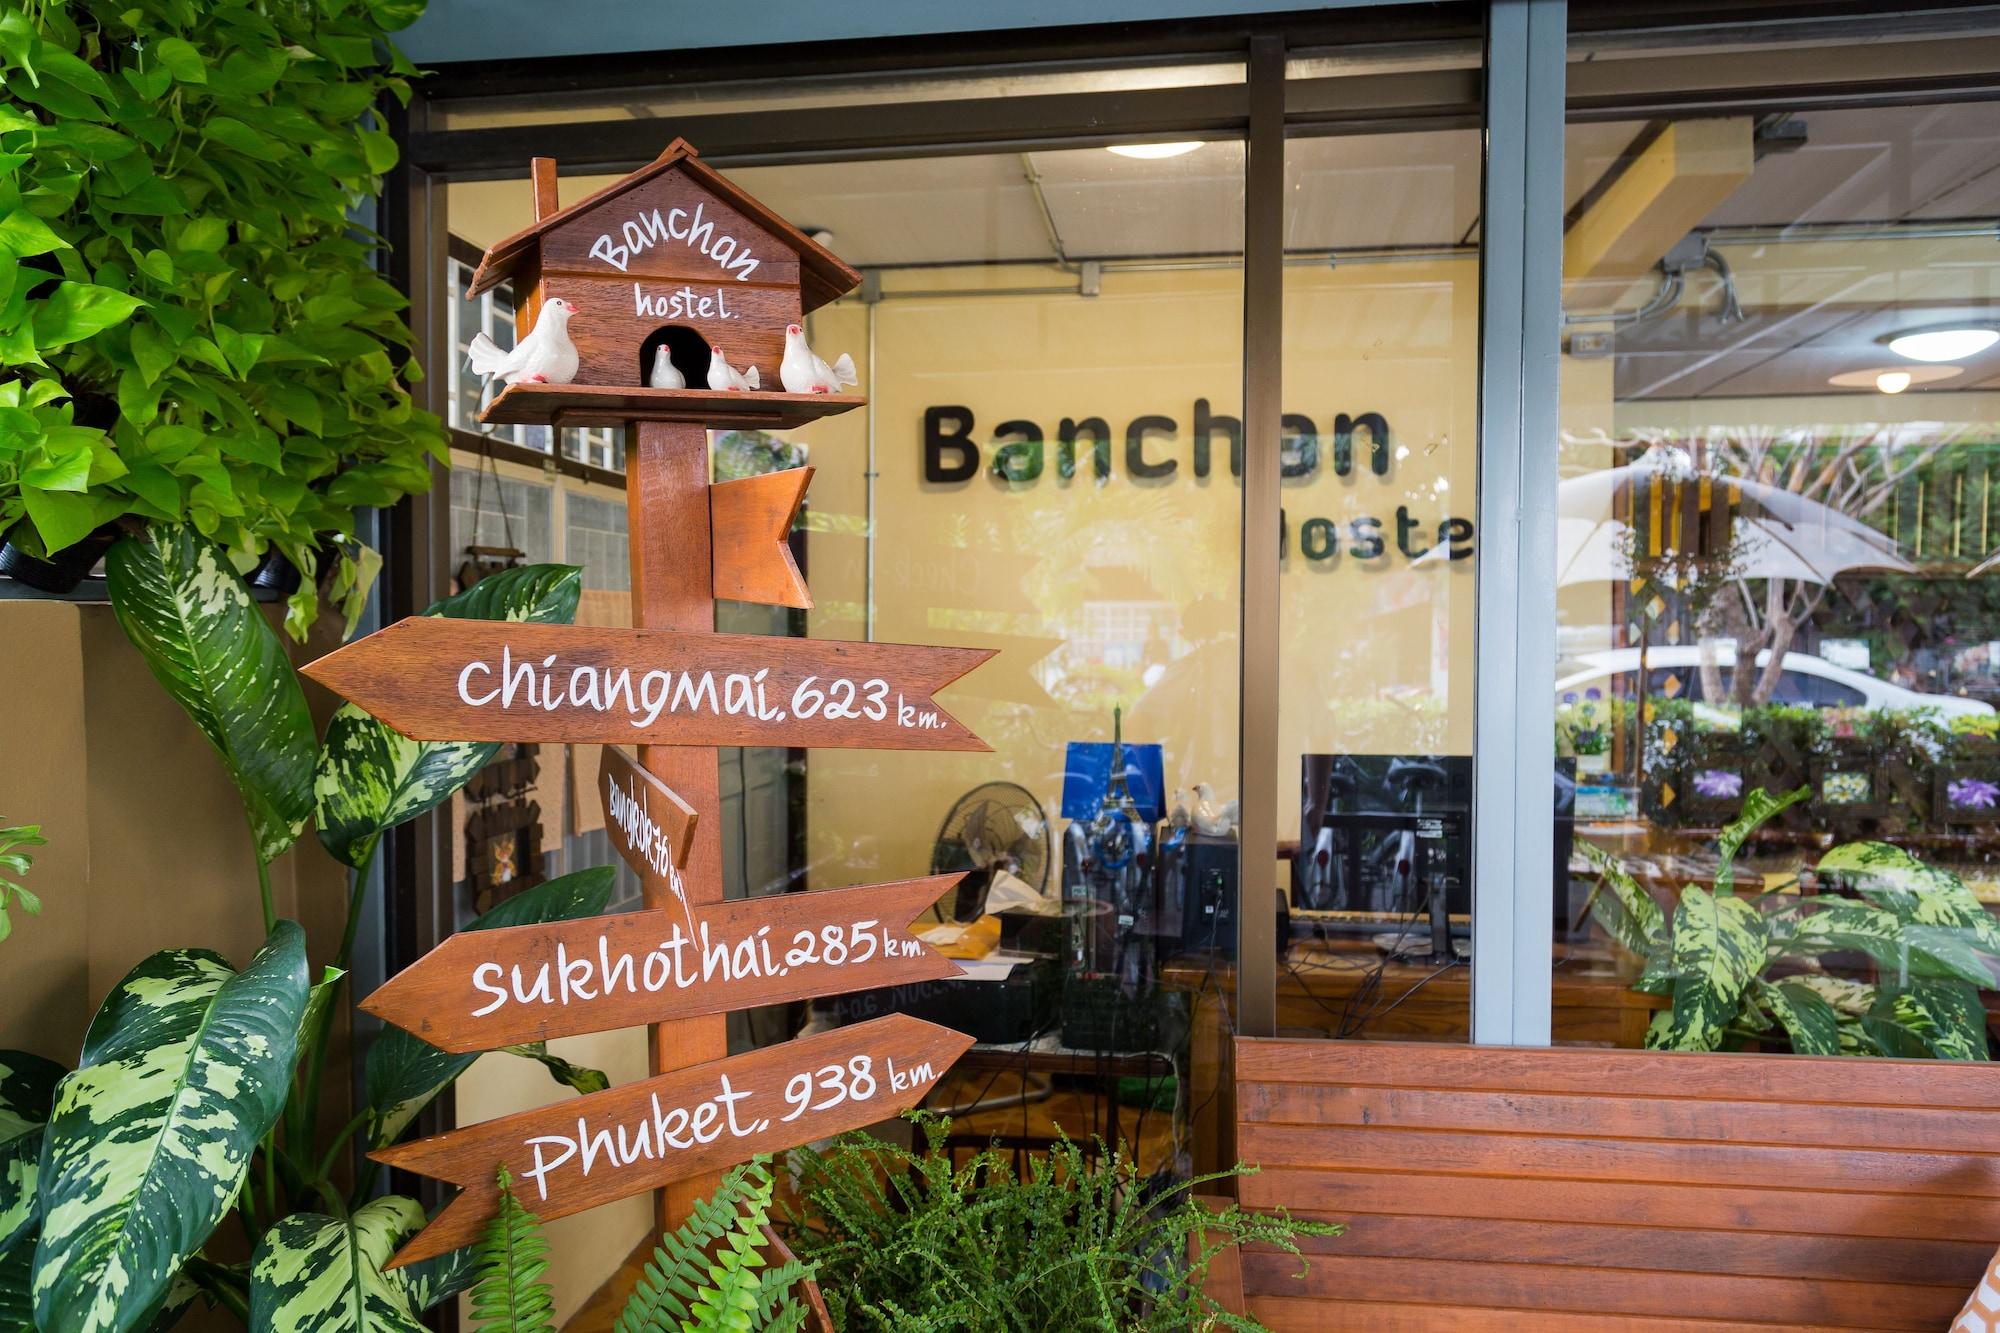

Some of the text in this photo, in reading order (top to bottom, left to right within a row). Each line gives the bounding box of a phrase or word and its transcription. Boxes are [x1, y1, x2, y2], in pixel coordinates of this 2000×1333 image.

[588, 202, 761, 282] Banchan
[633, 281, 740, 320] hostel.
[923, 397, 1390, 484] Banchan
[1279, 505, 1475, 562] oste
[897, 692, 949, 731] km.
[883, 927, 926, 960] km.
[780, 1054, 878, 1122] 938
[887, 1057, 946, 1095] km.
